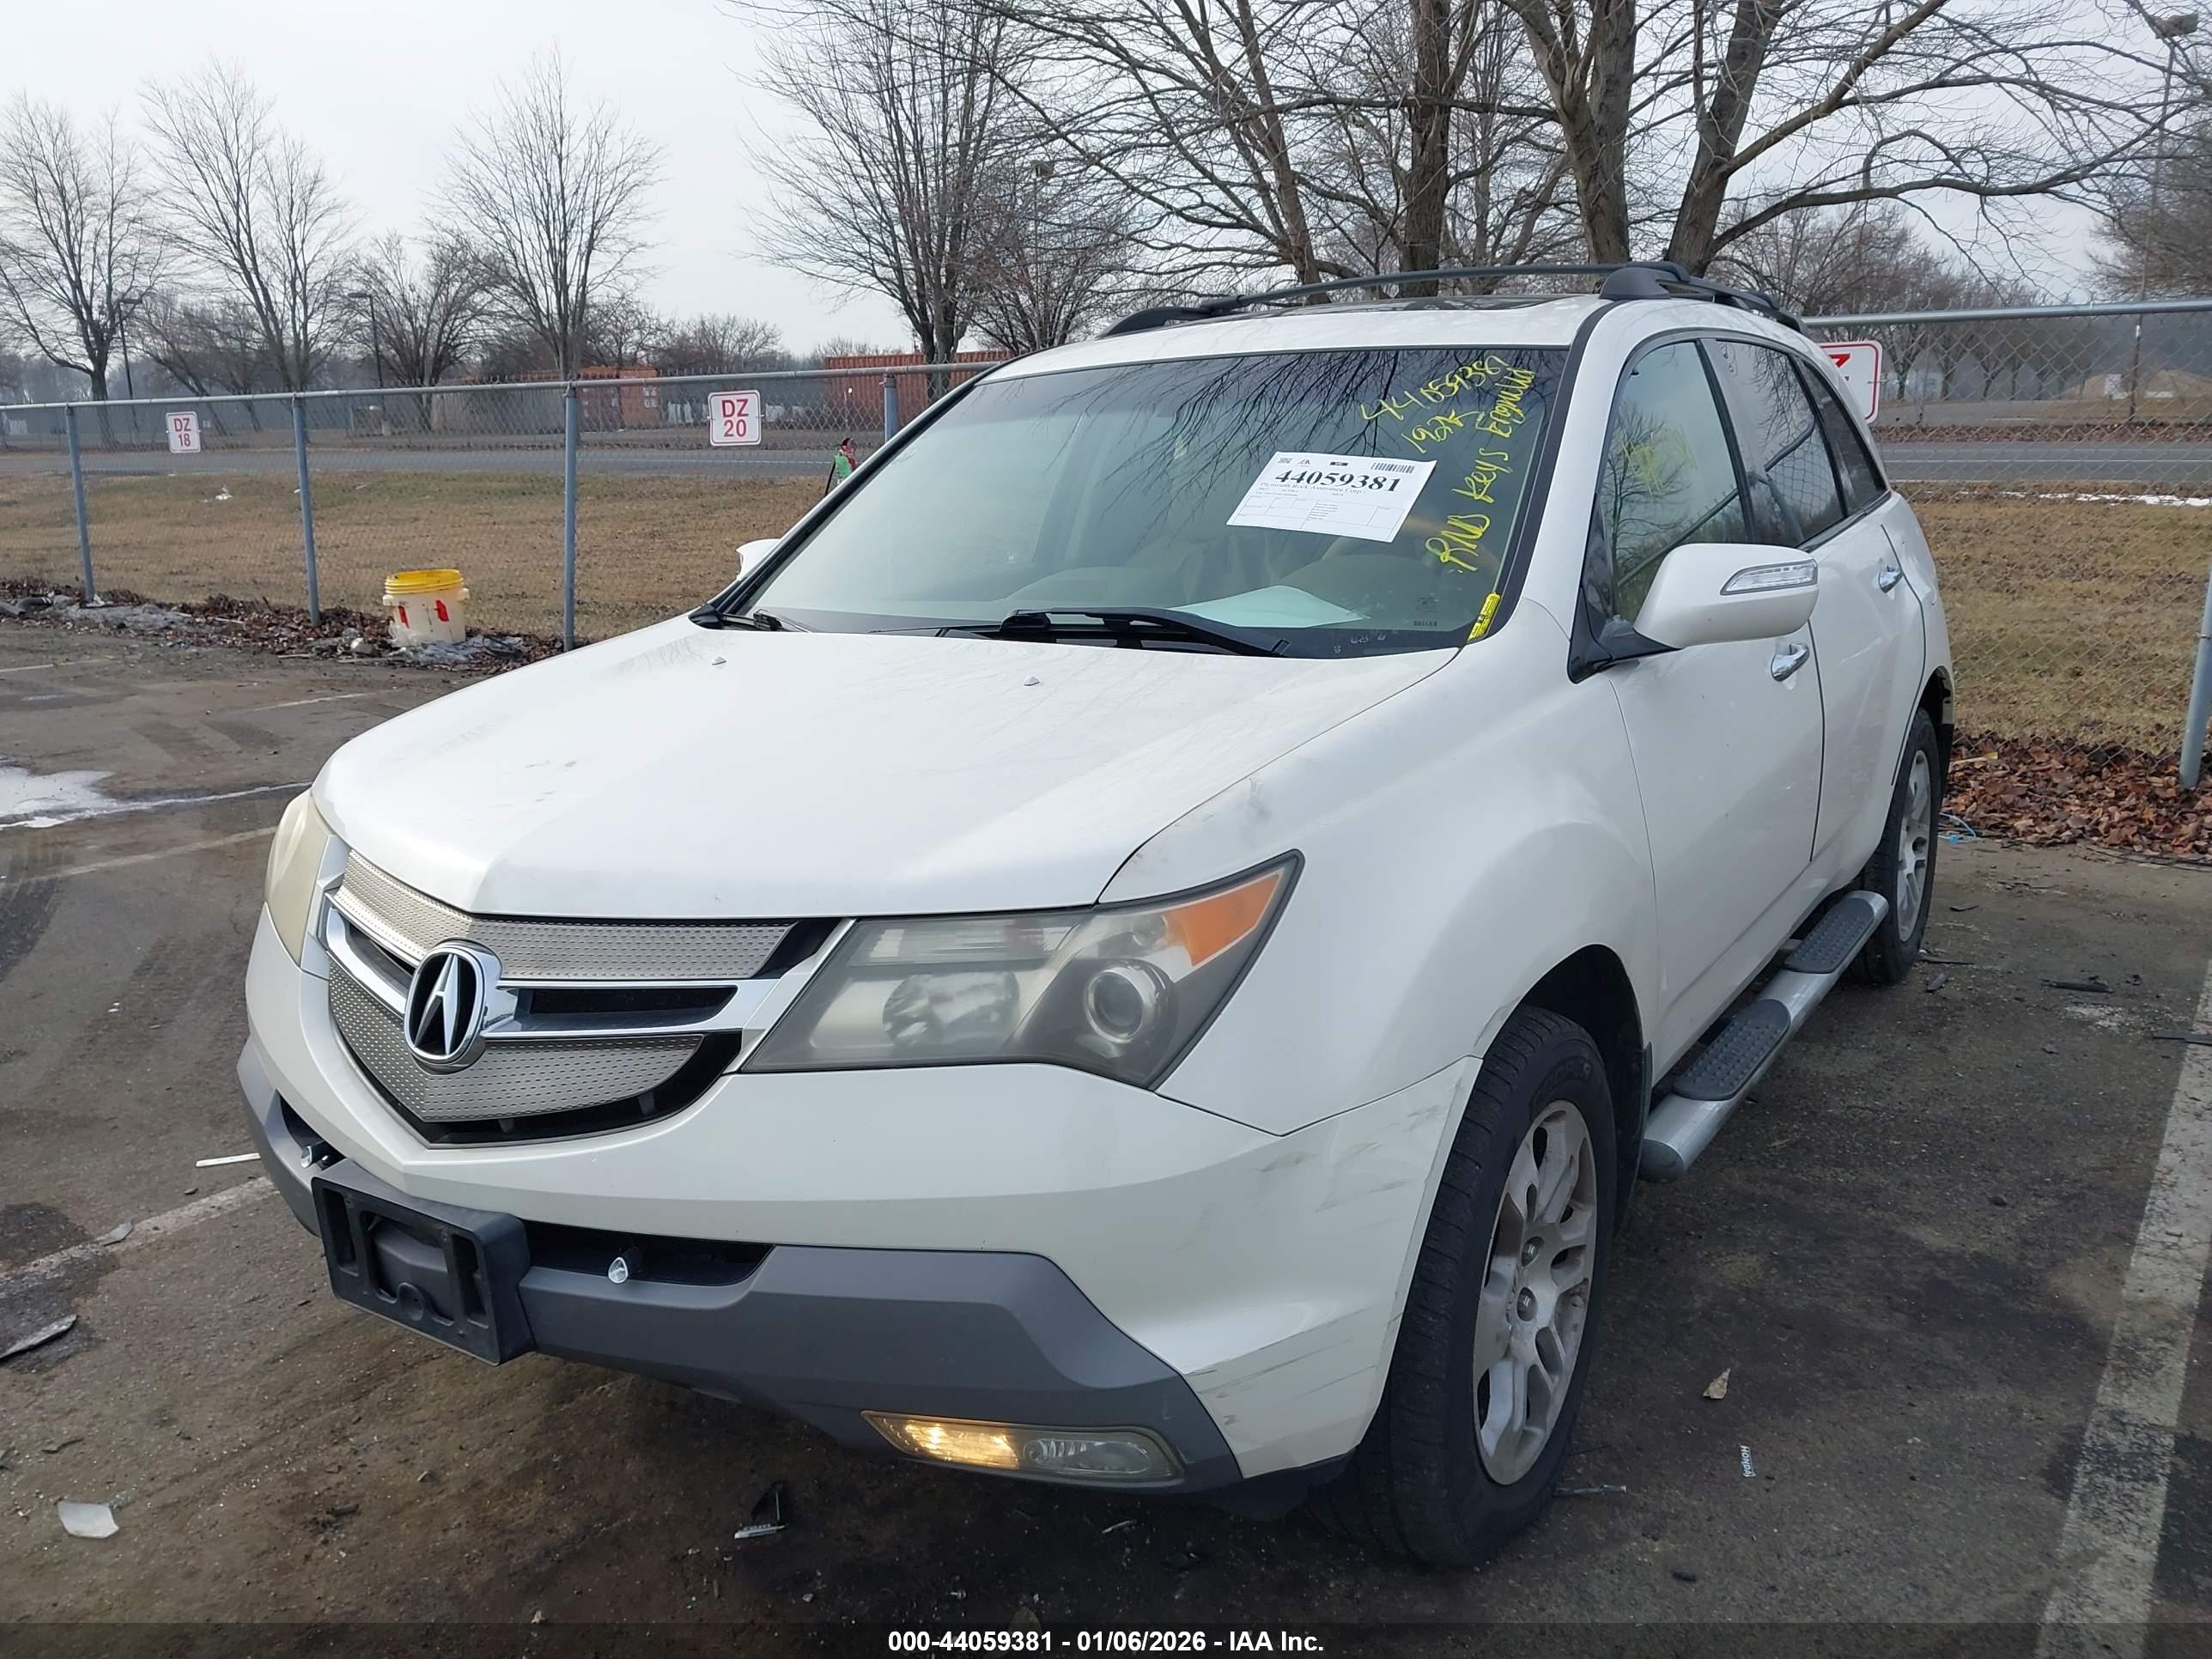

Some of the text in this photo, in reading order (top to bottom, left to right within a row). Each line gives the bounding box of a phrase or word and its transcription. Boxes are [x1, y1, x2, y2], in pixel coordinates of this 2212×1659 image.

[722, 398, 749, 417] DZ
[173, 417, 191, 432] DZ
[724, 419, 746, 436] 20
[179, 433, 191, 447] 18
[1275, 469, 1401, 492] 44059381
[1740, 1445, 1752, 1475] HONDA
